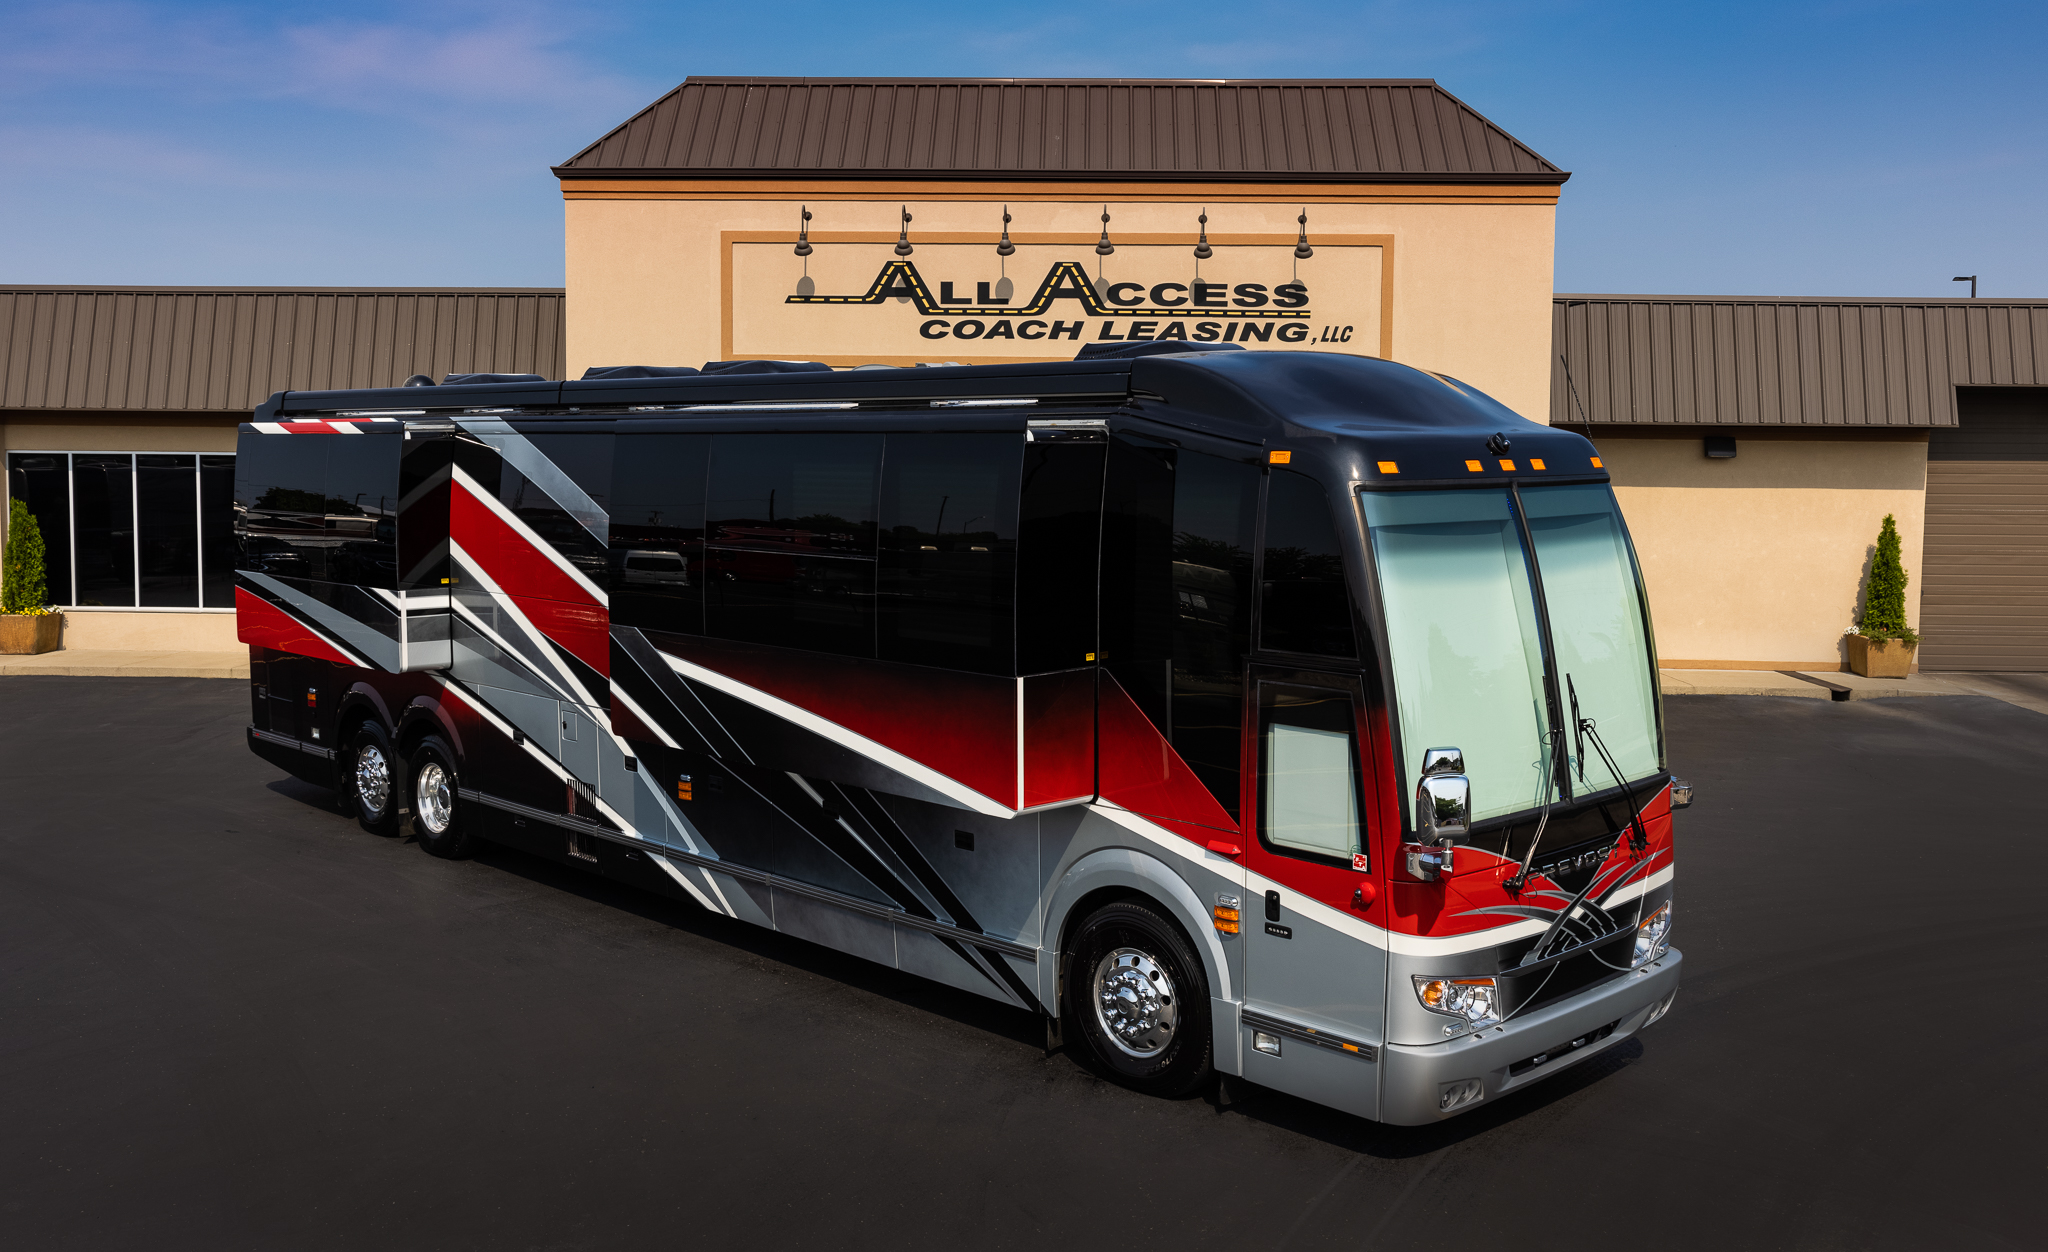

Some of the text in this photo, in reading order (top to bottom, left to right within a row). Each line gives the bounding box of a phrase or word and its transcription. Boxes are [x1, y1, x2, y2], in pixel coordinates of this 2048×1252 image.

[866, 261, 1309, 316] ALL ACCESS
[919, 319, 1085, 340] COACH
[1321, 326, 1354, 343] LLC
[1527, 843, 1620, 885] PREVOST
